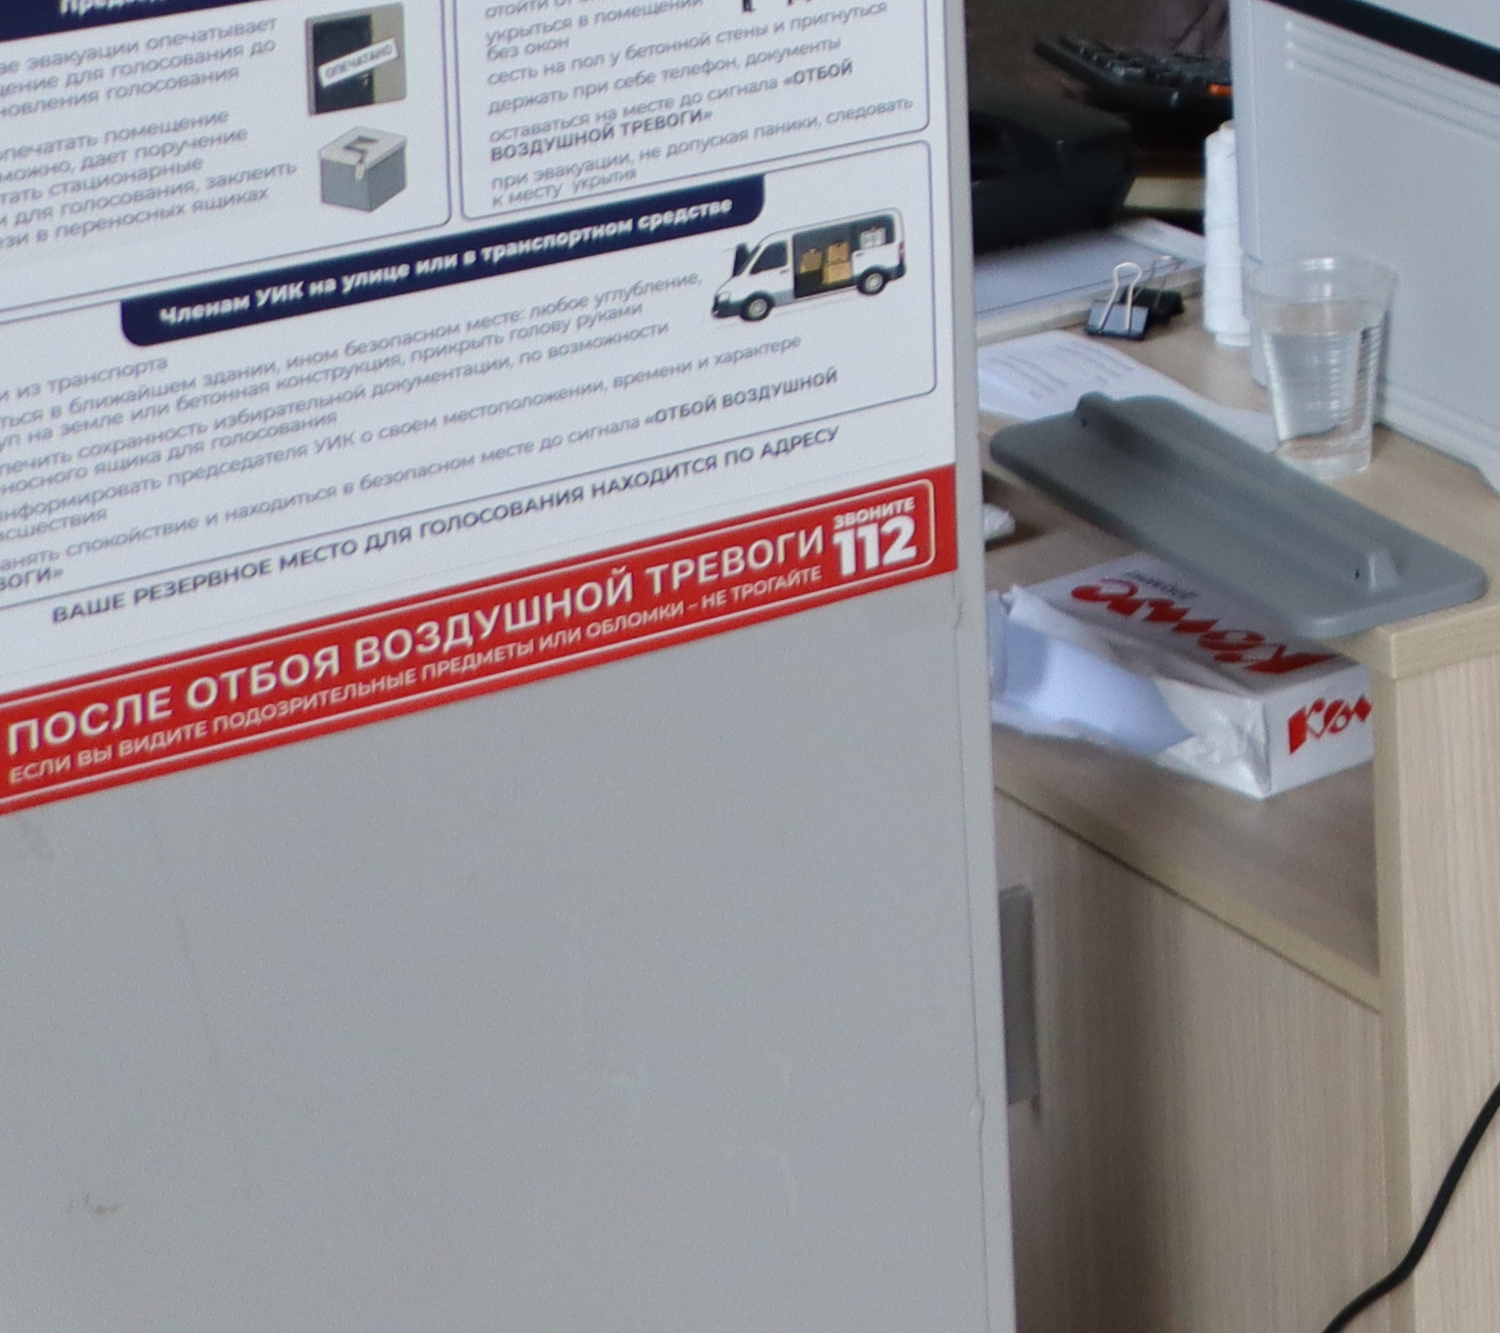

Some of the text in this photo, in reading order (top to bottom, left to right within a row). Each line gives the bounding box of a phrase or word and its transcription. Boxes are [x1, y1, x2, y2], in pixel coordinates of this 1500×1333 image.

[486, 1, 887, 85] сесть на пол у бетонной стены и пригнуться
[79, 128, 248, 172] дает поручение
[489, 108, 712, 162] ВОЗДУШНОЙ ТРЕВОГИ»
[13, 205, 53, 227] для
[205, 162, 297, 190] заклеить
[159, 198, 732, 324] Членам УИК на улице или в транспортном средстве
[76, 422, 208, 459] сохранность
[212, 384, 366, 431] избирательной
[518, 349, 542, 365] по
[546, 321, 669, 359] возможности
[644, 366, 837, 424] «ОТБОЙ ВОЗДУШНОЙ
[51, 425, 838, 624] ВАШЕ РЕЗЕРВНОЕ МЕСТО ДЛЯ ГОЛОСОВАНИЯ НАХОДИТСЯ ПО АДРЕСУ
[832, 515, 917, 576] 112
[833, 496, 915, 530] ЗВОНИТЕ
[7, 524, 823, 755] ПОСЛЕ ОТБОЯ ВОЗДУШНОЙ ТРЕВОГИ
[8, 754, 71, 784] ЕСЛИ
[76, 744, 112, 768] ВЫ
[117, 719, 207, 758] ВИДИТЕ
[211, 667, 416, 733] ПОДОЗРИТЕЛЬНЫЕ
[420, 638, 534, 681] ПРЕДМЕТЫ
[538, 626, 581, 652] ИЛИ
[585, 600, 684, 639] ОБЛОМКИ
[701, 588, 727, 609] НЕ
[729, 564, 821, 601] ТРОГАЙТЕ
